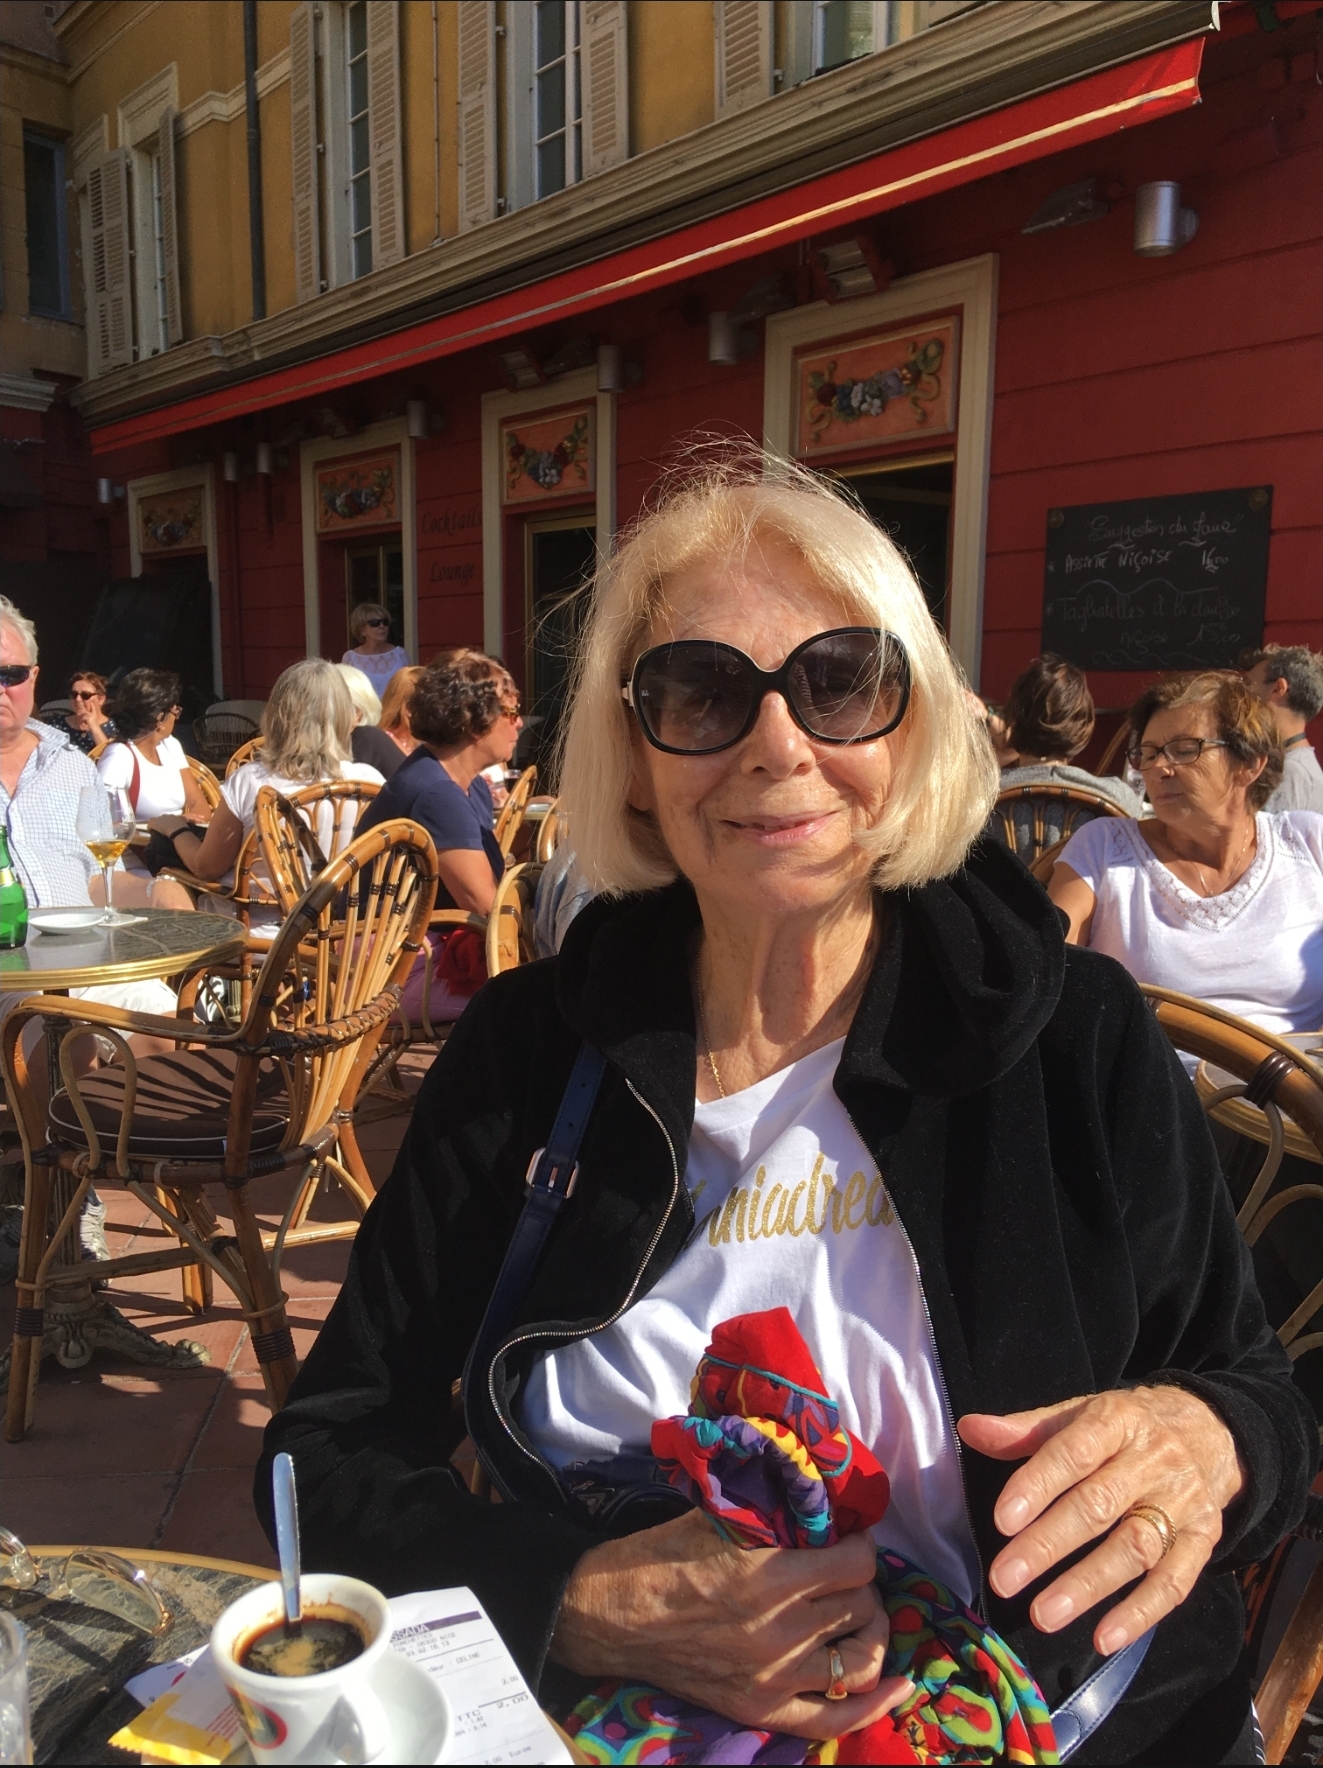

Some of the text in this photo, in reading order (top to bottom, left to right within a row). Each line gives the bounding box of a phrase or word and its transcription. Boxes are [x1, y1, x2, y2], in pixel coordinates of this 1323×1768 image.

[1168, 514, 1187, 535] du
[430, 561, 476, 587] Lounge
[416, 1638, 437, 1648] 06300
[440, 1631, 457, 1641] NICE
[456, 1651, 481, 1663] CELINE
[501, 1675, 519, 1685] 2.00
[456, 1694, 529, 1722] TTC 2.00
[509, 1746, 532, 1758] Euros
